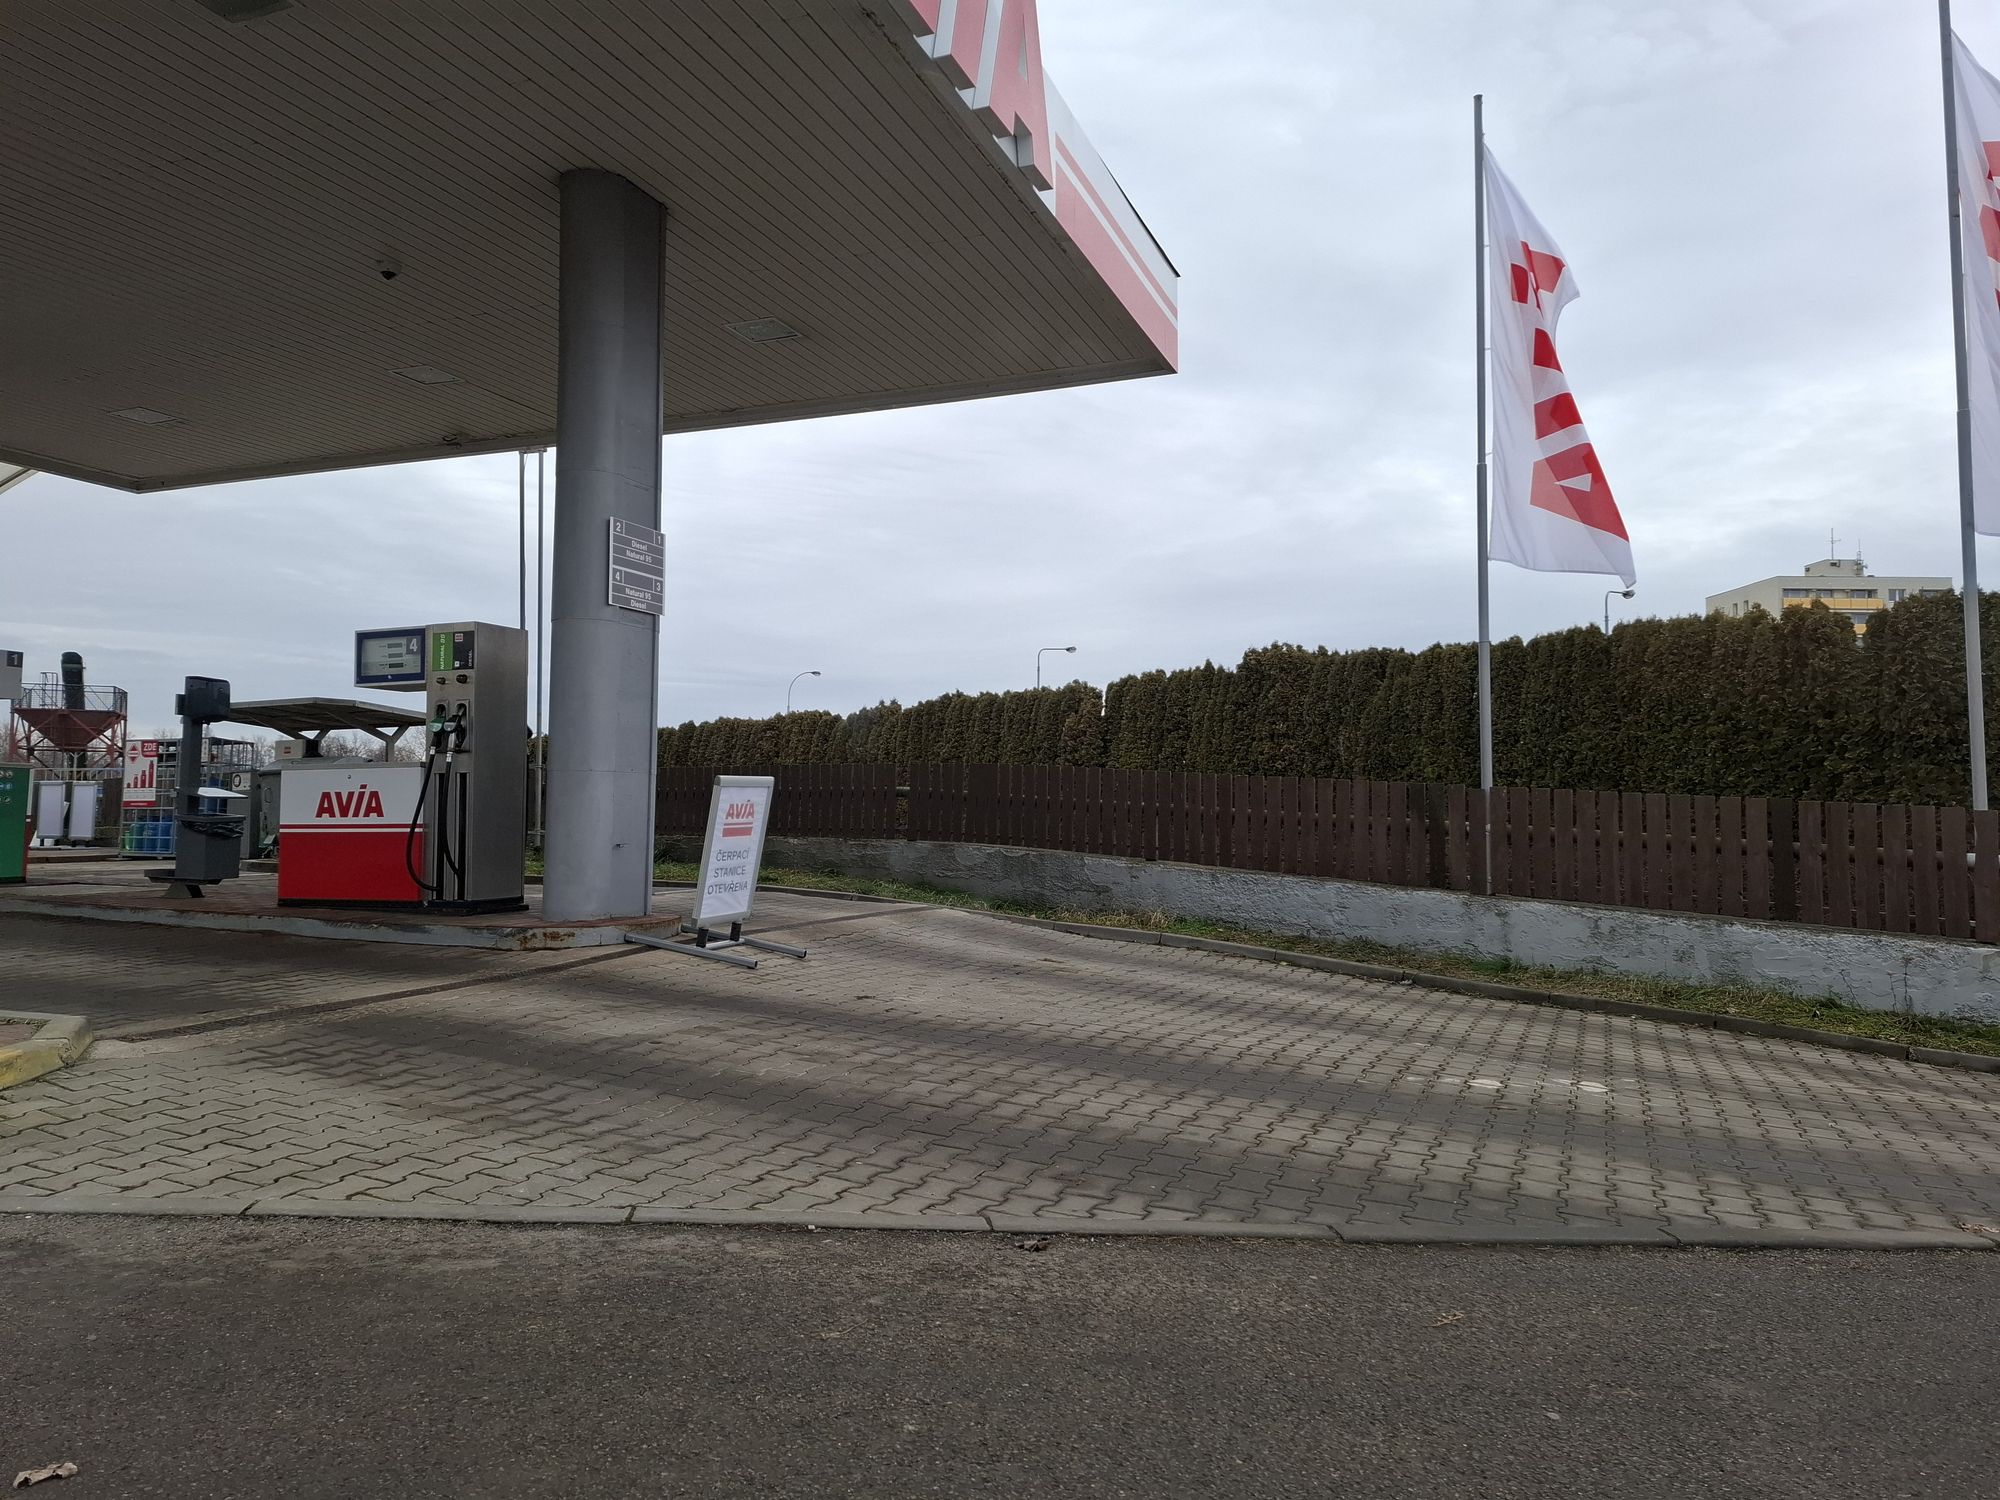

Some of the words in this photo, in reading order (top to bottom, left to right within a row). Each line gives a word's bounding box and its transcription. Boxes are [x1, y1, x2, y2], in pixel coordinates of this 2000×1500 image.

[616, 522, 621, 532] 2
[631, 540, 648, 551] Diesel
[657, 535, 661, 544] 1
[626, 549, 645, 561] Natural
[645, 555, 652, 563] 95
[615, 571, 620, 581] 4
[656, 582, 661, 591] 3
[625, 587, 645, 598] Natural
[644, 591, 652, 600] 95
[630, 599, 647, 609] Diesel
[409, 638, 418, 652] 4
[11, 653, 18, 665] 1
[143, 743, 157, 751] ZDE
[315, 784, 384, 818] AVIA
[725, 800, 755, 820] AVIA
[716, 848, 750, 862] ČERPACÍ
[713, 865, 746, 879] STANICE
[707, 882, 748, 895] OTEVŘENA
